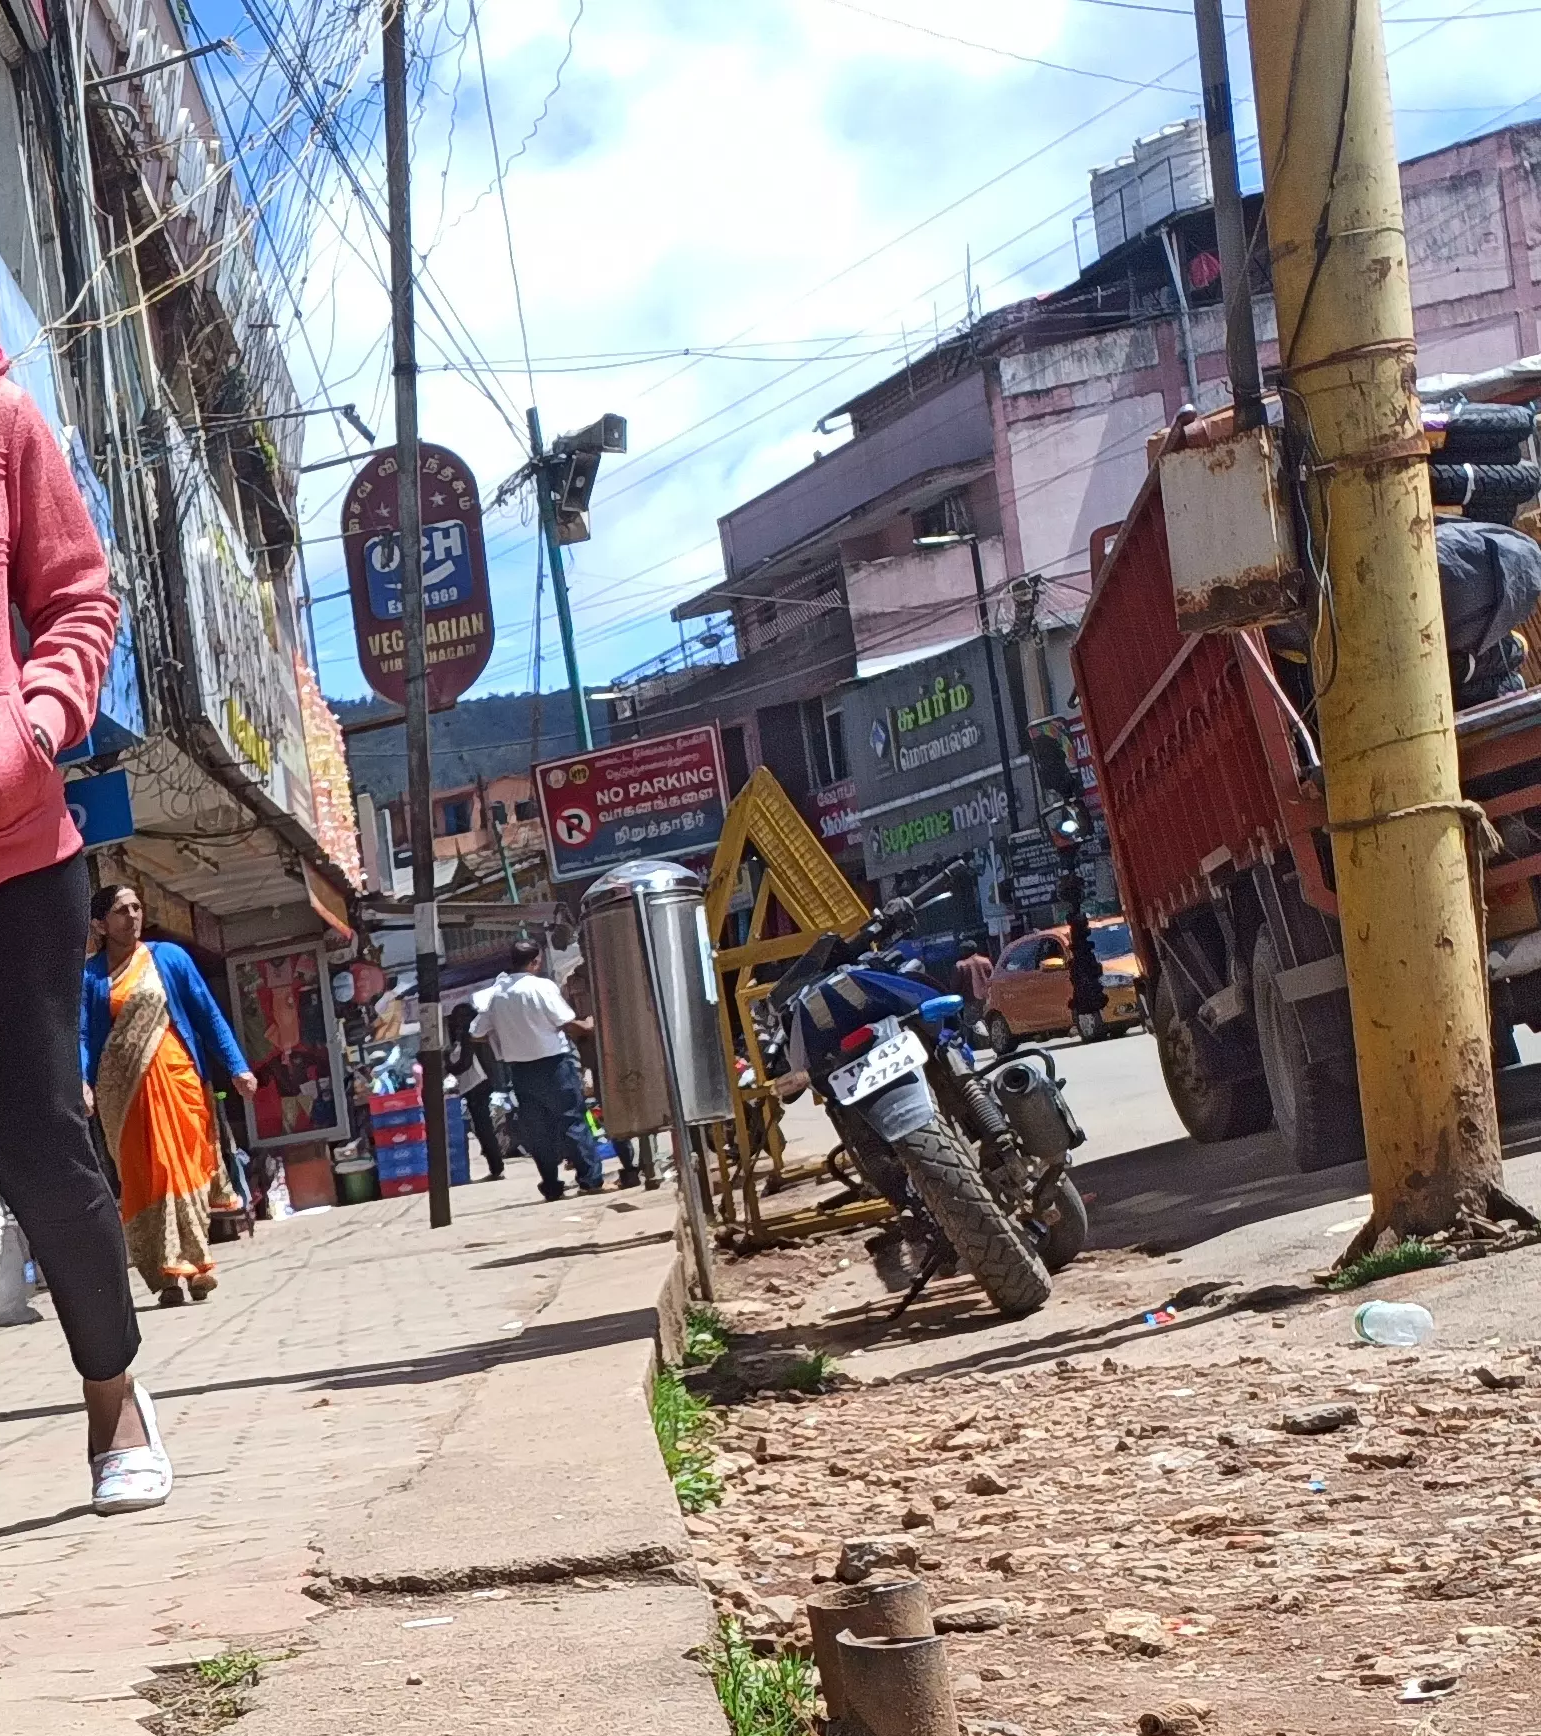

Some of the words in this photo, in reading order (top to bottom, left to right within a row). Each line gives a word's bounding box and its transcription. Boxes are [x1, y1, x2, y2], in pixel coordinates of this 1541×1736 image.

[422, 586, 458, 607] 1989
[367, 612, 484, 657] VEGARIAN
[595, 787, 624, 806] NO
[628, 766, 714, 798] PARKING
[598, 787, 714, 823] வாகனங்களை
[614, 809, 706, 846] நிறுத்தாதீர்
[882, 811, 951, 854] supreme
